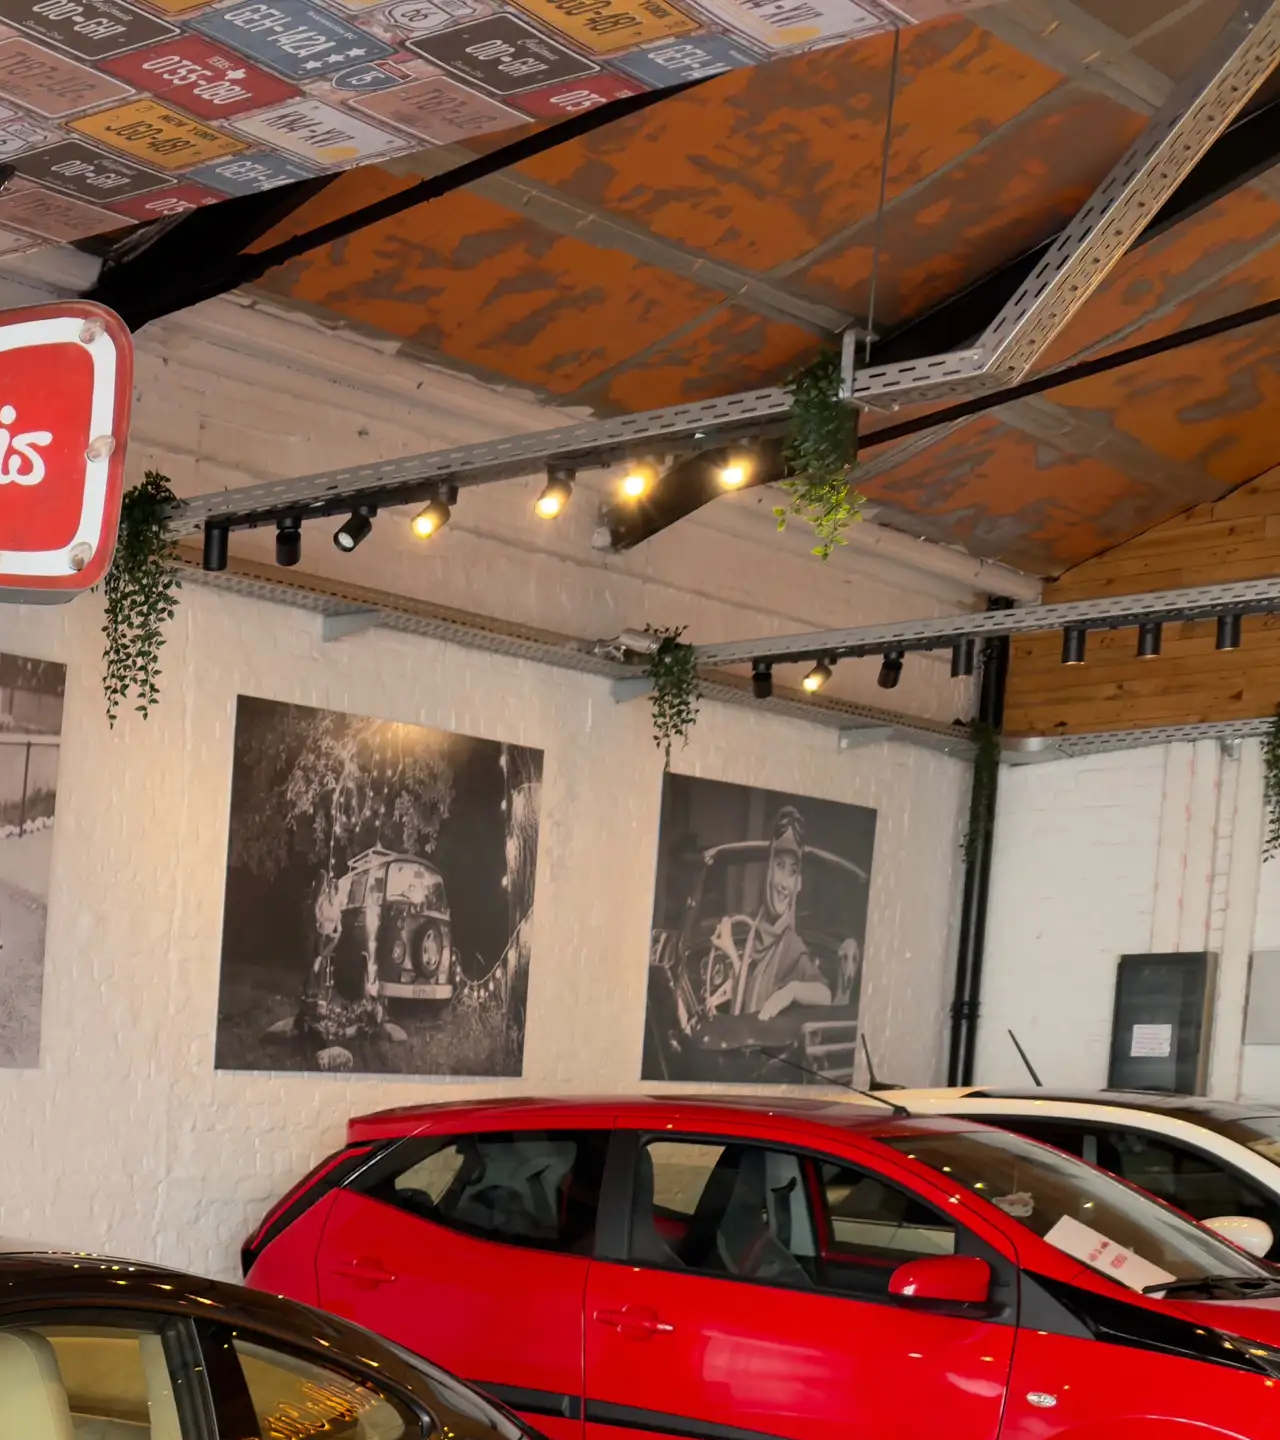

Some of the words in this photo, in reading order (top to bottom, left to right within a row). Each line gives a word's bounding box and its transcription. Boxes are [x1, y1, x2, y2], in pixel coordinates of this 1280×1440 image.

[223, 1, 330, 58] GEH-142A
[345, 70, 383, 86] 15
[256, 110, 357, 149] KN4-XV1
